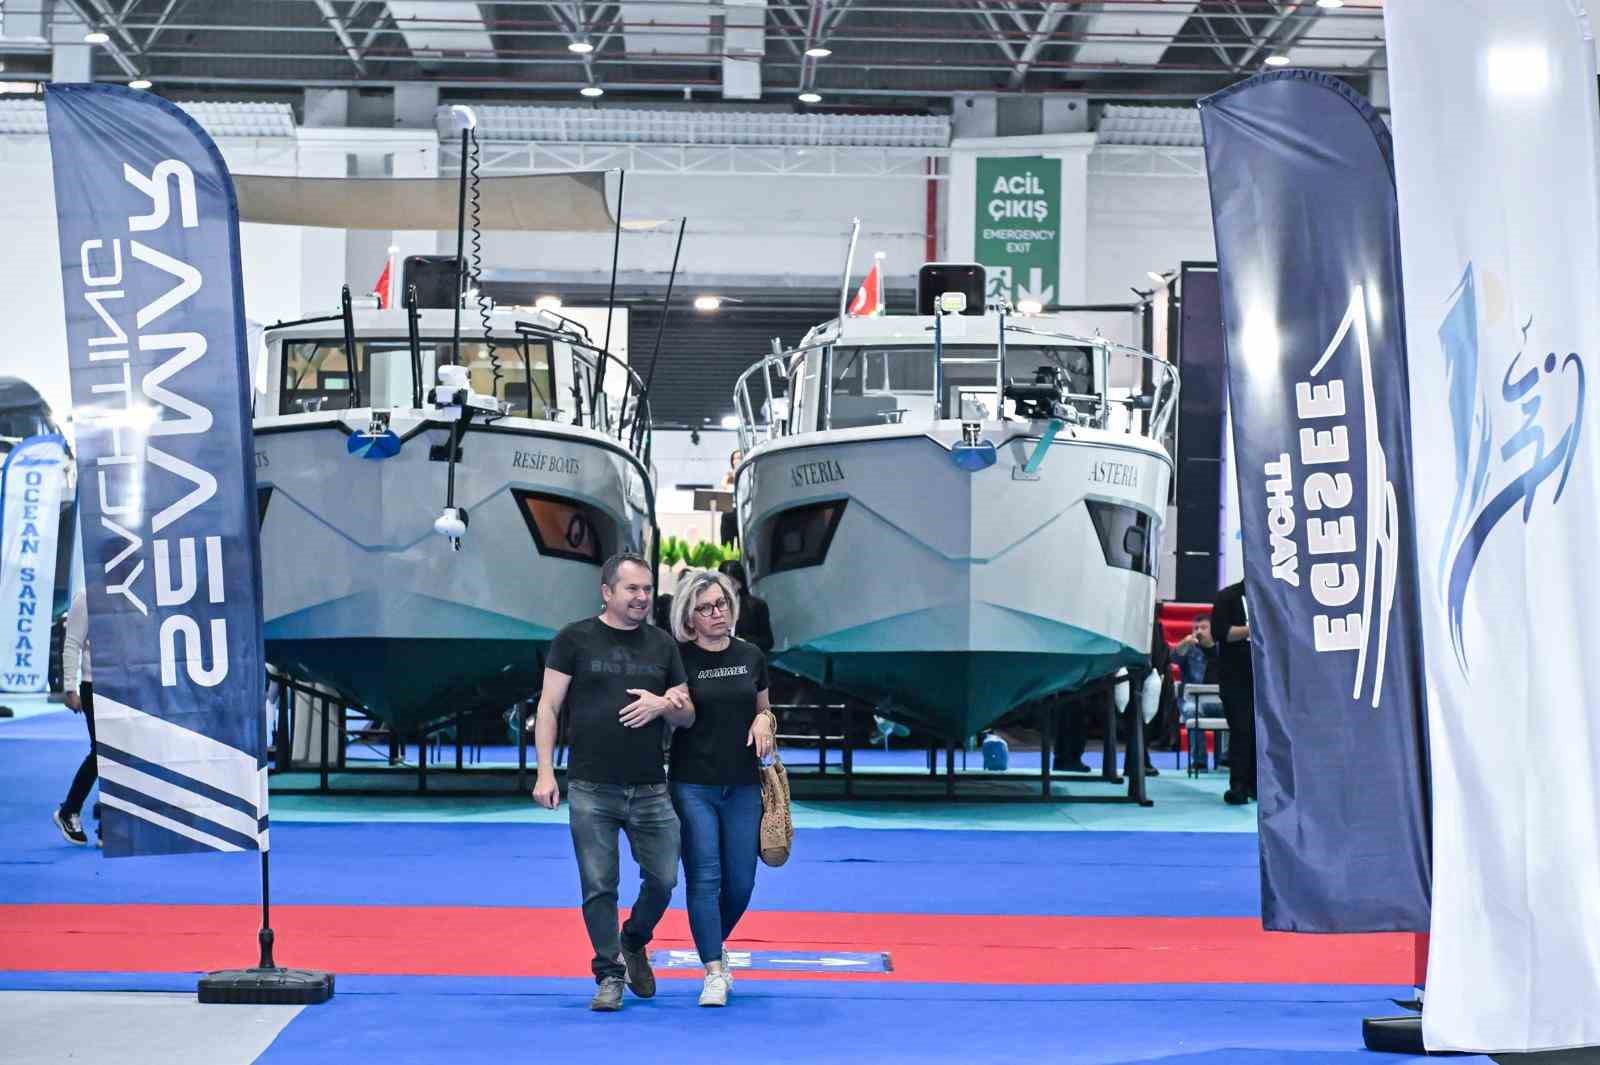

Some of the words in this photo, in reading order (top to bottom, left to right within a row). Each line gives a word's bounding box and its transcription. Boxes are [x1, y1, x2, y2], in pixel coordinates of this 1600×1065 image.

[993, 171, 1045, 194] ACİL
[988, 199, 1049, 222] ÇIKIŞ
[983, 228, 1056, 240] EMERGENCY
[1006, 241, 1032, 253] EXIT
[548, 454, 581, 475] BOATS
[21, 471, 42, 554] OCEAN
[16, 567, 36, 668] SANCAK
[3, 673, 40, 686] YAT
